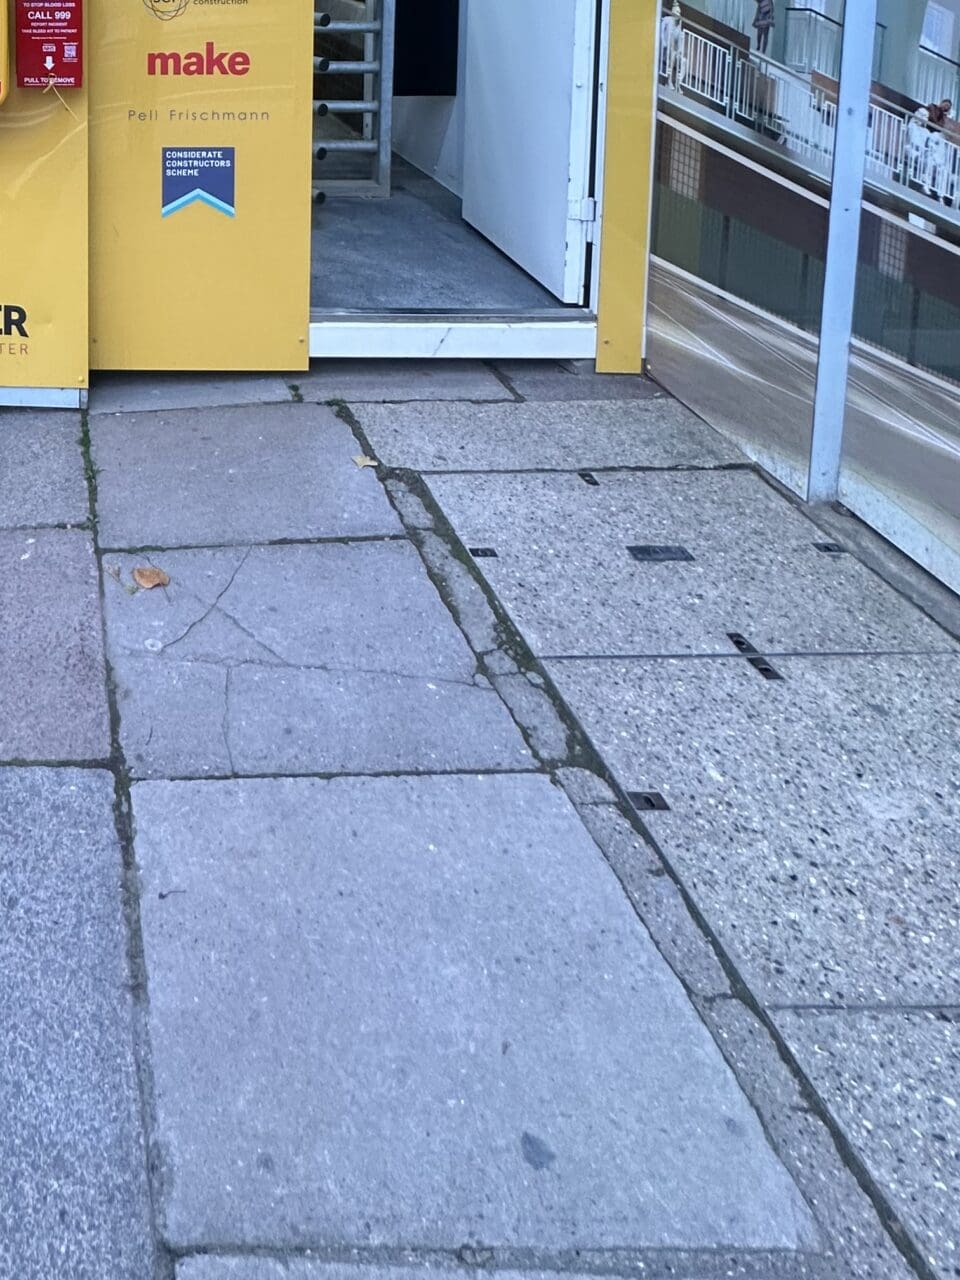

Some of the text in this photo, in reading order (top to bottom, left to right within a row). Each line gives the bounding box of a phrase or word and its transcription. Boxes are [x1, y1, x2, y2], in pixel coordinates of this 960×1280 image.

[28, 11, 71, 19] CALL 999
[147, 41, 250, 76] make
[128, 109, 269, 121] Pell Frischmann
[166, 151, 223, 159] CONSIDERATE
[166, 160, 231, 168] CONSTRUCTORS
[166, 169, 199, 177] SCHEME
